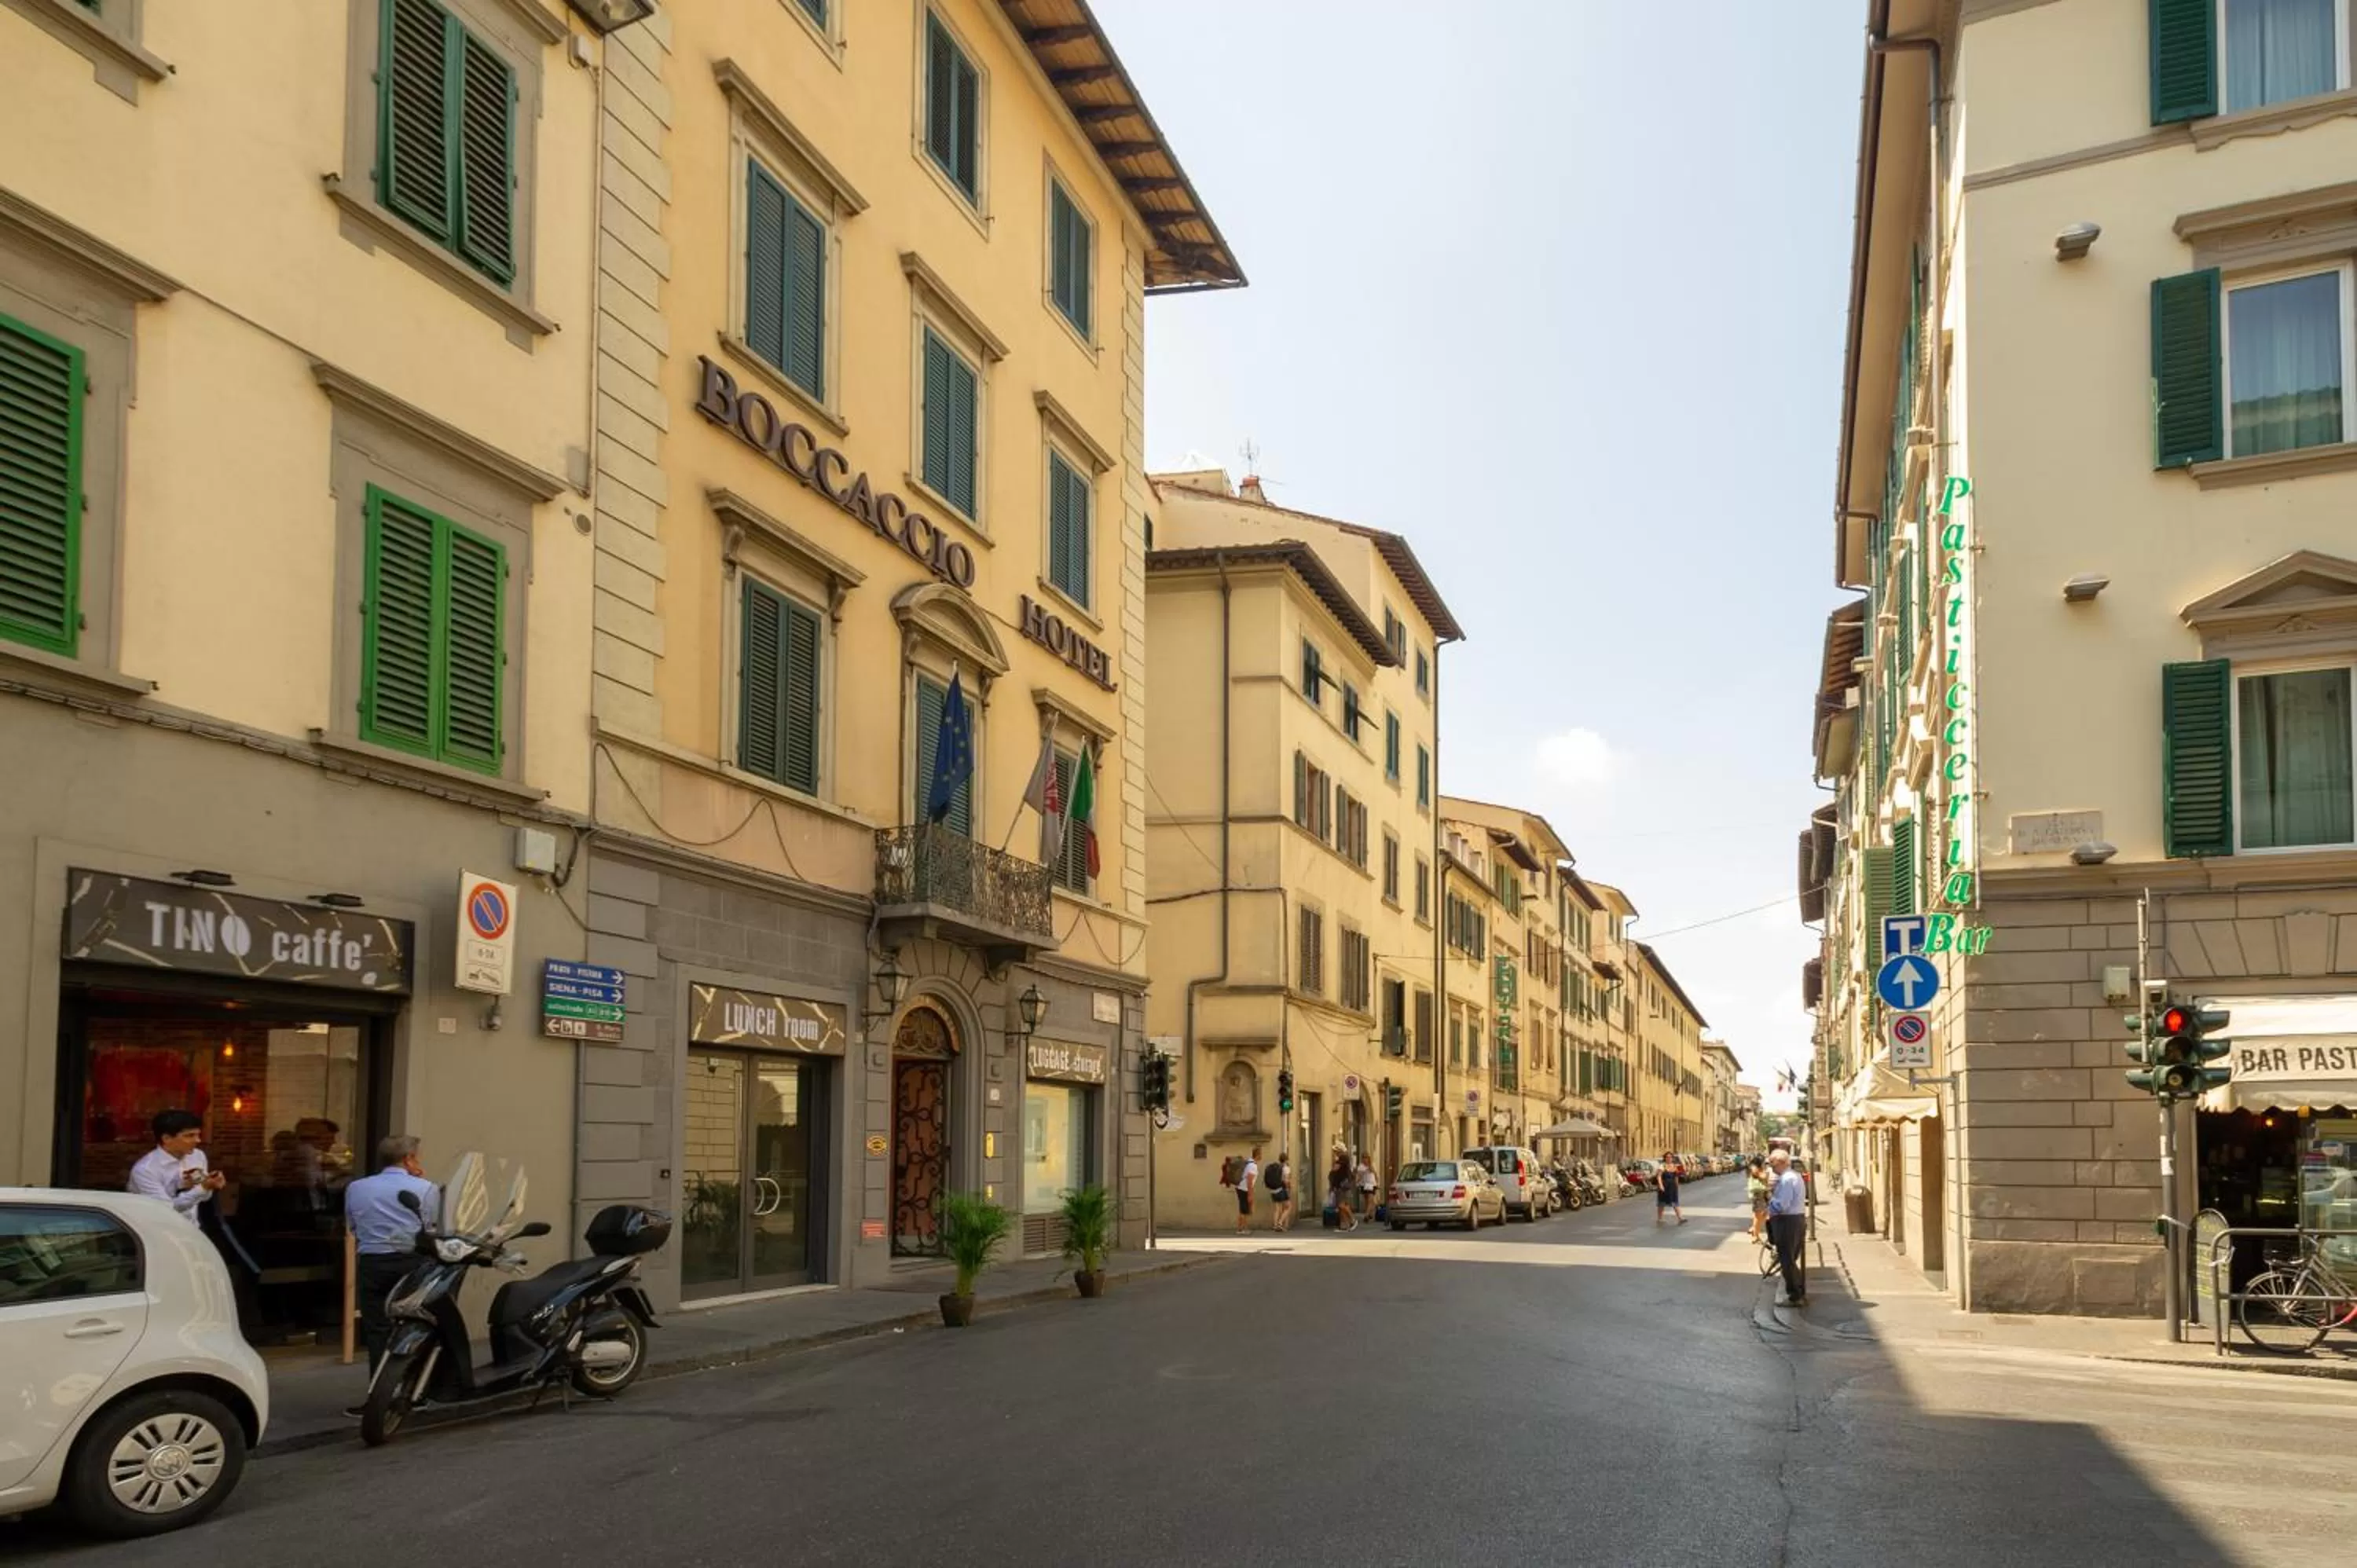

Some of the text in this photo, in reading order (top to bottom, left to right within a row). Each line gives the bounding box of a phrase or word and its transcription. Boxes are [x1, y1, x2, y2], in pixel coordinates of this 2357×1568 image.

[695, 355, 976, 590] BOCCACCIO
[1019, 594, 1118, 692] HOTEL
[1938, 474, 1970, 905] Pasticceria
[145, 900, 251, 957] TINO
[1922, 913, 1992, 955] Bar
[724, 1002, 819, 1041] LUNCH room
[1033, 1046, 1069, 1071] LUGGAGE
[2241, 1048, 2288, 1072] BAR
